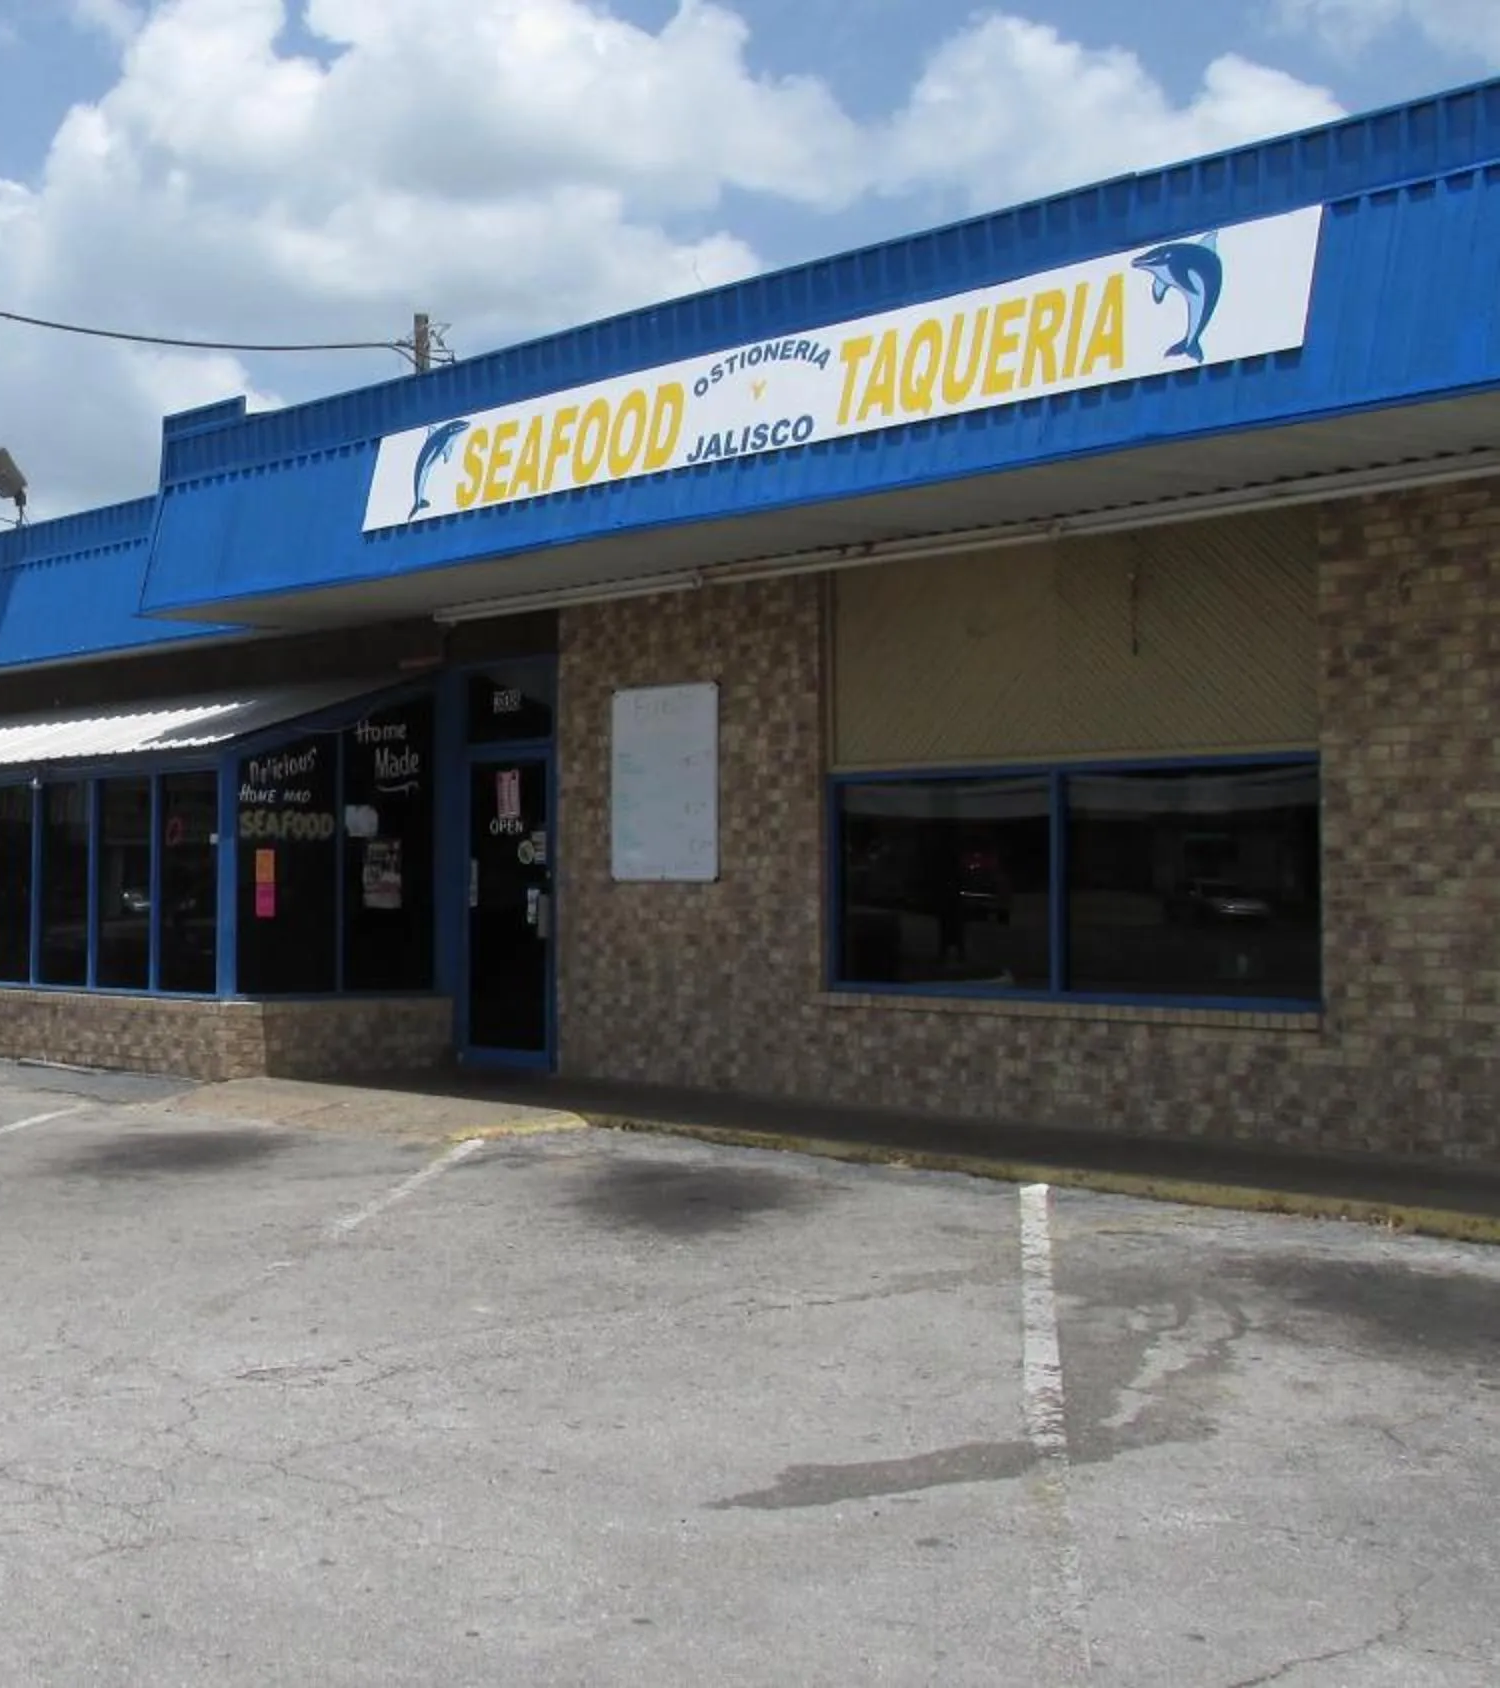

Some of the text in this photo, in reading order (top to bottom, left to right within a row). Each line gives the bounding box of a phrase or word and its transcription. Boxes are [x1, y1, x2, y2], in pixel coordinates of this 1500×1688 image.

[834, 273, 1125, 426] TAQUERIA
[693, 339, 831, 397] OSTIONERIA
[751, 379, 767, 401] Y
[454, 380, 686, 509] SEAFOOD
[686, 414, 814, 463] JALISCO
[356, 719, 407, 745] Home
[374, 745, 420, 780] Made
[240, 809, 334, 841] SEAFOOD
[489, 817, 523, 835] OPEN
